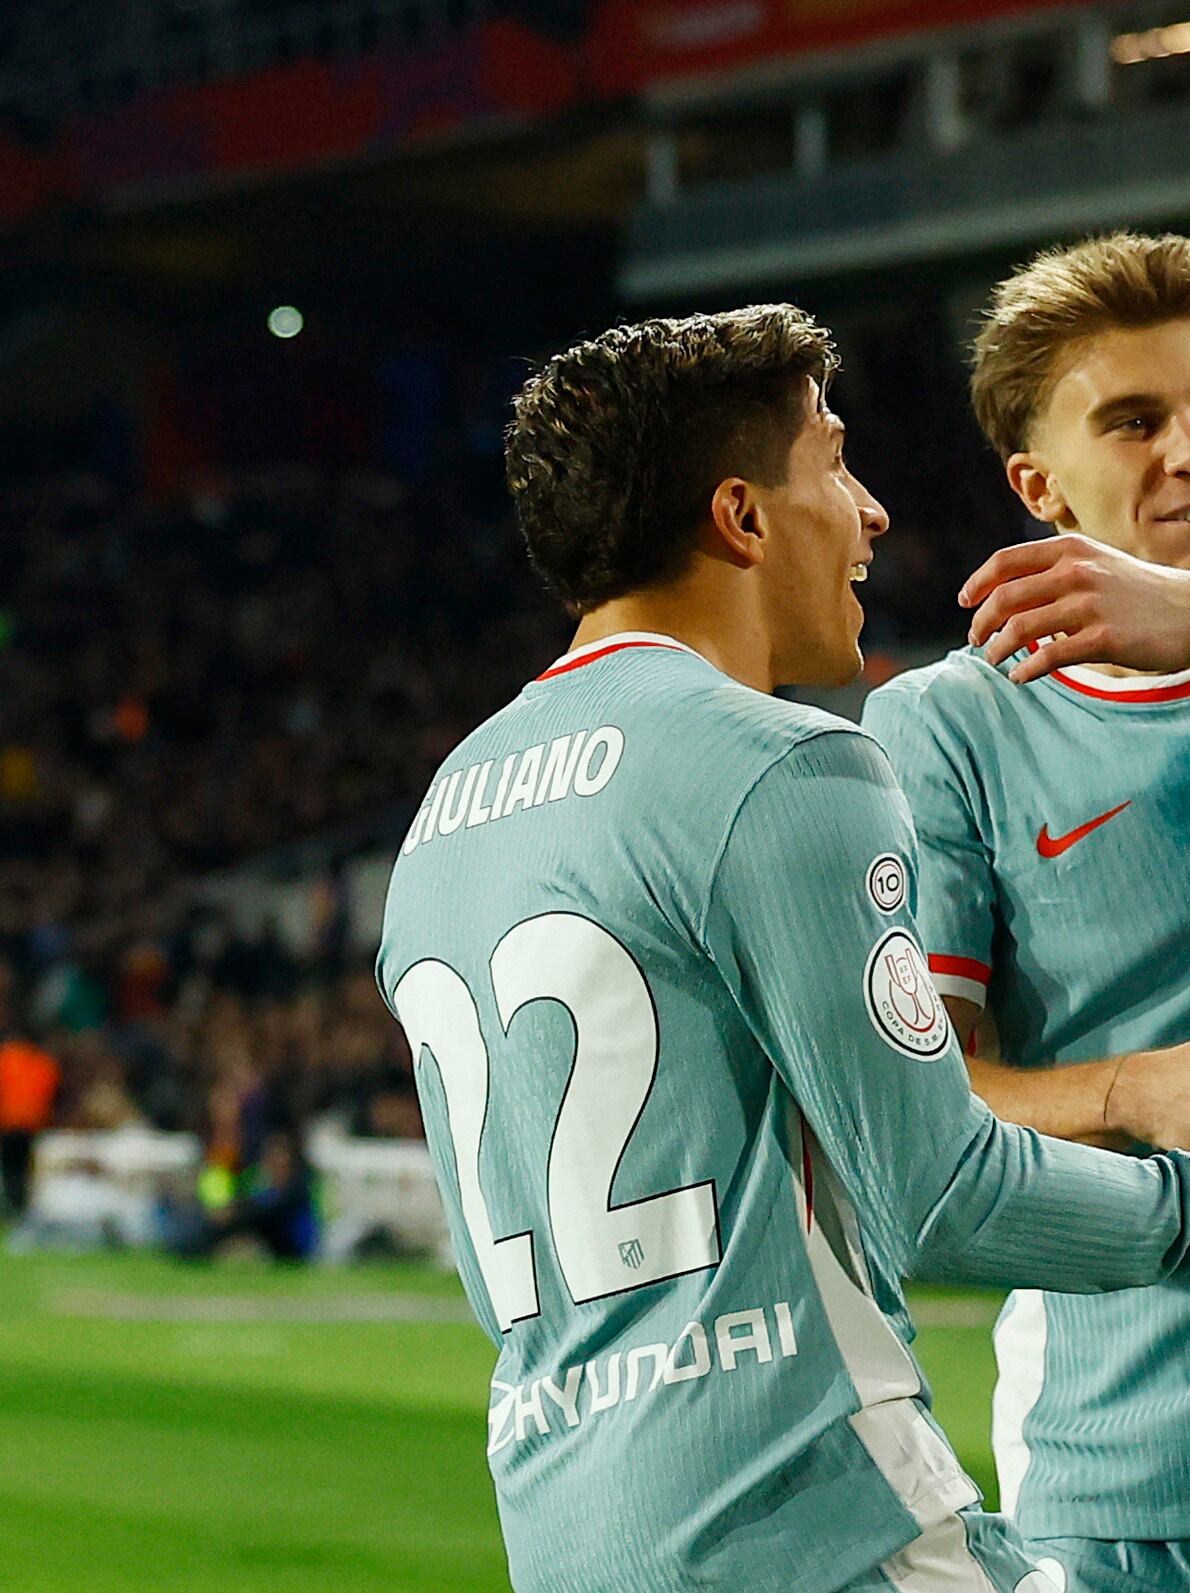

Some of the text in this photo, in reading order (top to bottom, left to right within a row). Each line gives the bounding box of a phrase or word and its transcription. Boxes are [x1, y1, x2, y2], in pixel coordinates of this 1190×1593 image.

[876, 873, 900, 894] 10
[882, 1000, 905, 1036] COPA
[907, 1033, 922, 1046] DE
[391, 910, 722, 1335] 22
[514, 1301, 799, 1441] HYUNDAI
